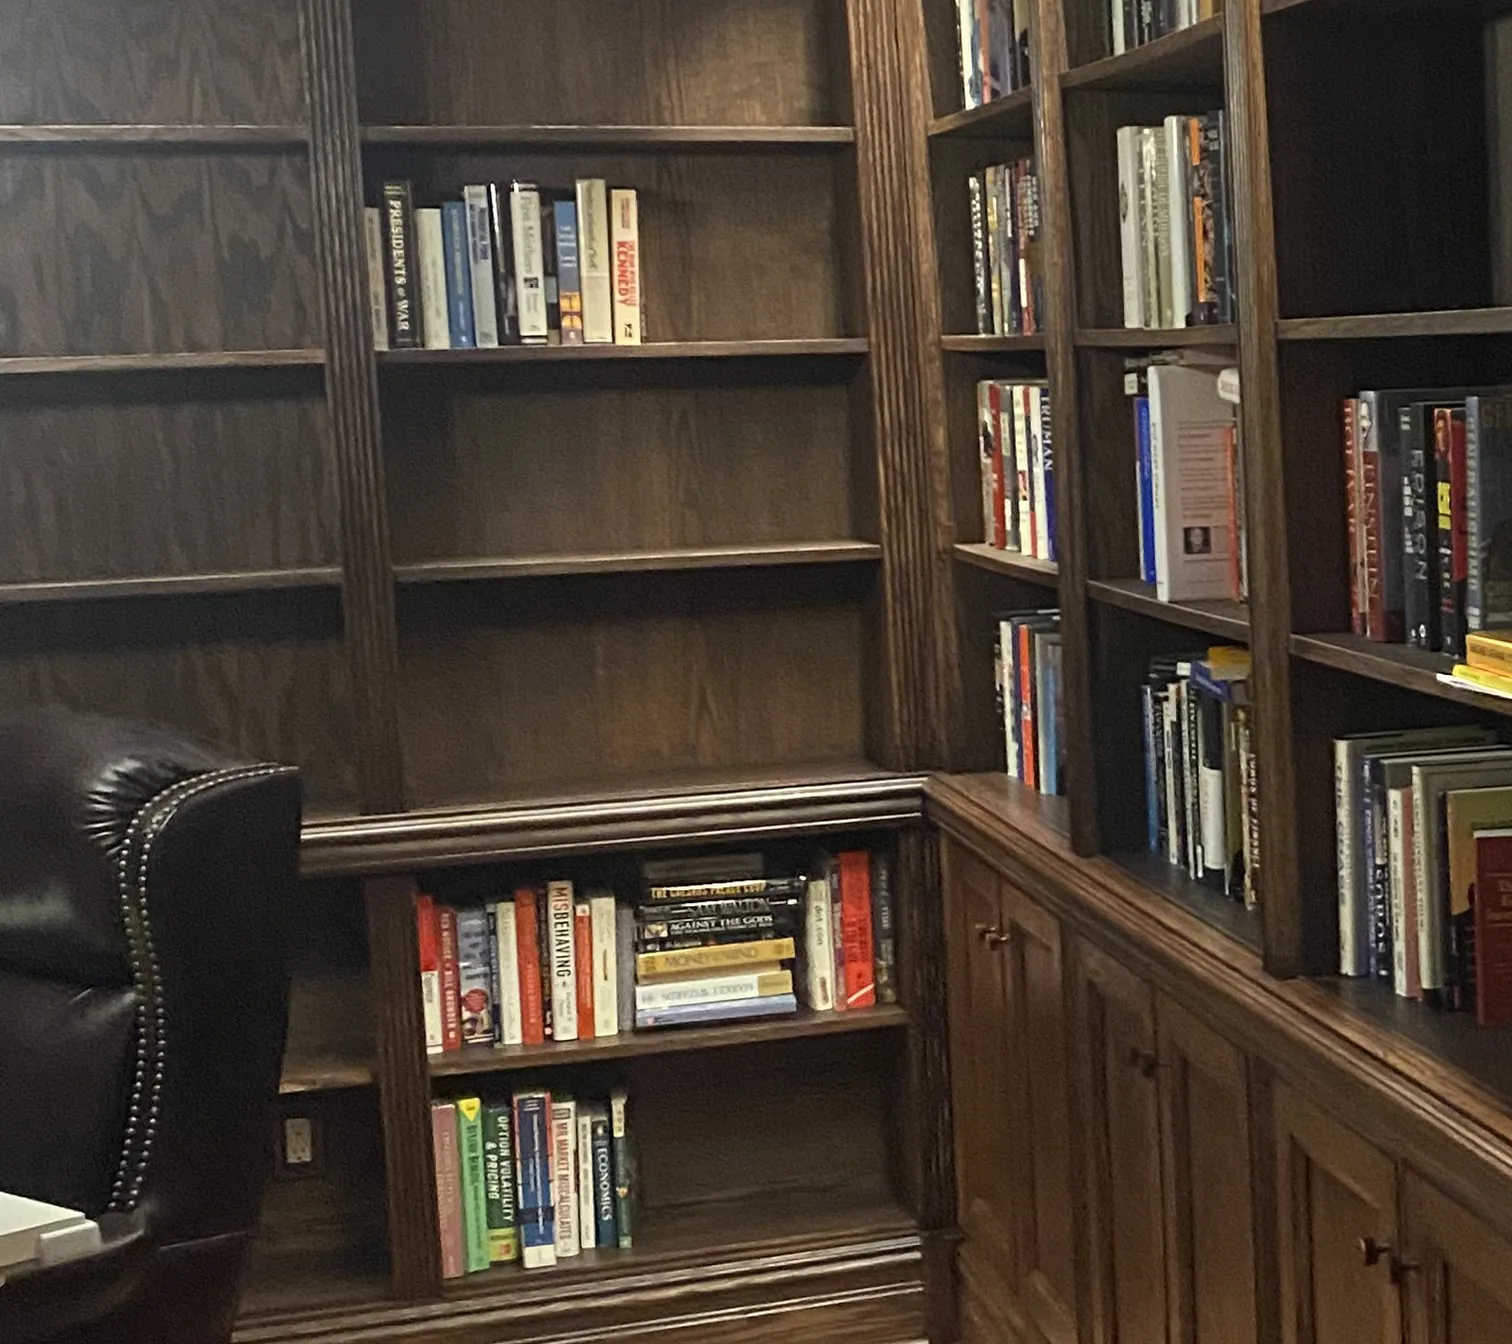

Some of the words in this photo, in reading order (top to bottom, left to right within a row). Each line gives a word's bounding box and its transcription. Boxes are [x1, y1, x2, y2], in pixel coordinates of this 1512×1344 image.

[389, 200, 406, 285] PRESIDENTS
[617, 241, 629, 306] KENNEDY
[397, 299, 410, 330] WAR
[1040, 396, 1052, 472] TRUMAN
[1363, 464, 1378, 597] EINSTEIN
[1411, 449, 1428, 580] EDISON
[552, 887, 571, 977] MISBEHAVING
[670, 920, 717, 931] AGAINST
[720, 918, 742, 928] THE
[743, 915, 773, 925] GODS
[485, 1141, 494, 1150] &
[497, 1116, 511, 1155] OPTION
[556, 1139, 570, 1172] MARKET
[486, 1155, 500, 1199] PRICING
[500, 1161, 514, 1222] VOLATILITY
[558, 1174, 572, 1240] MISCALCULATES
[597, 1147, 613, 1221] ECONOMICS
